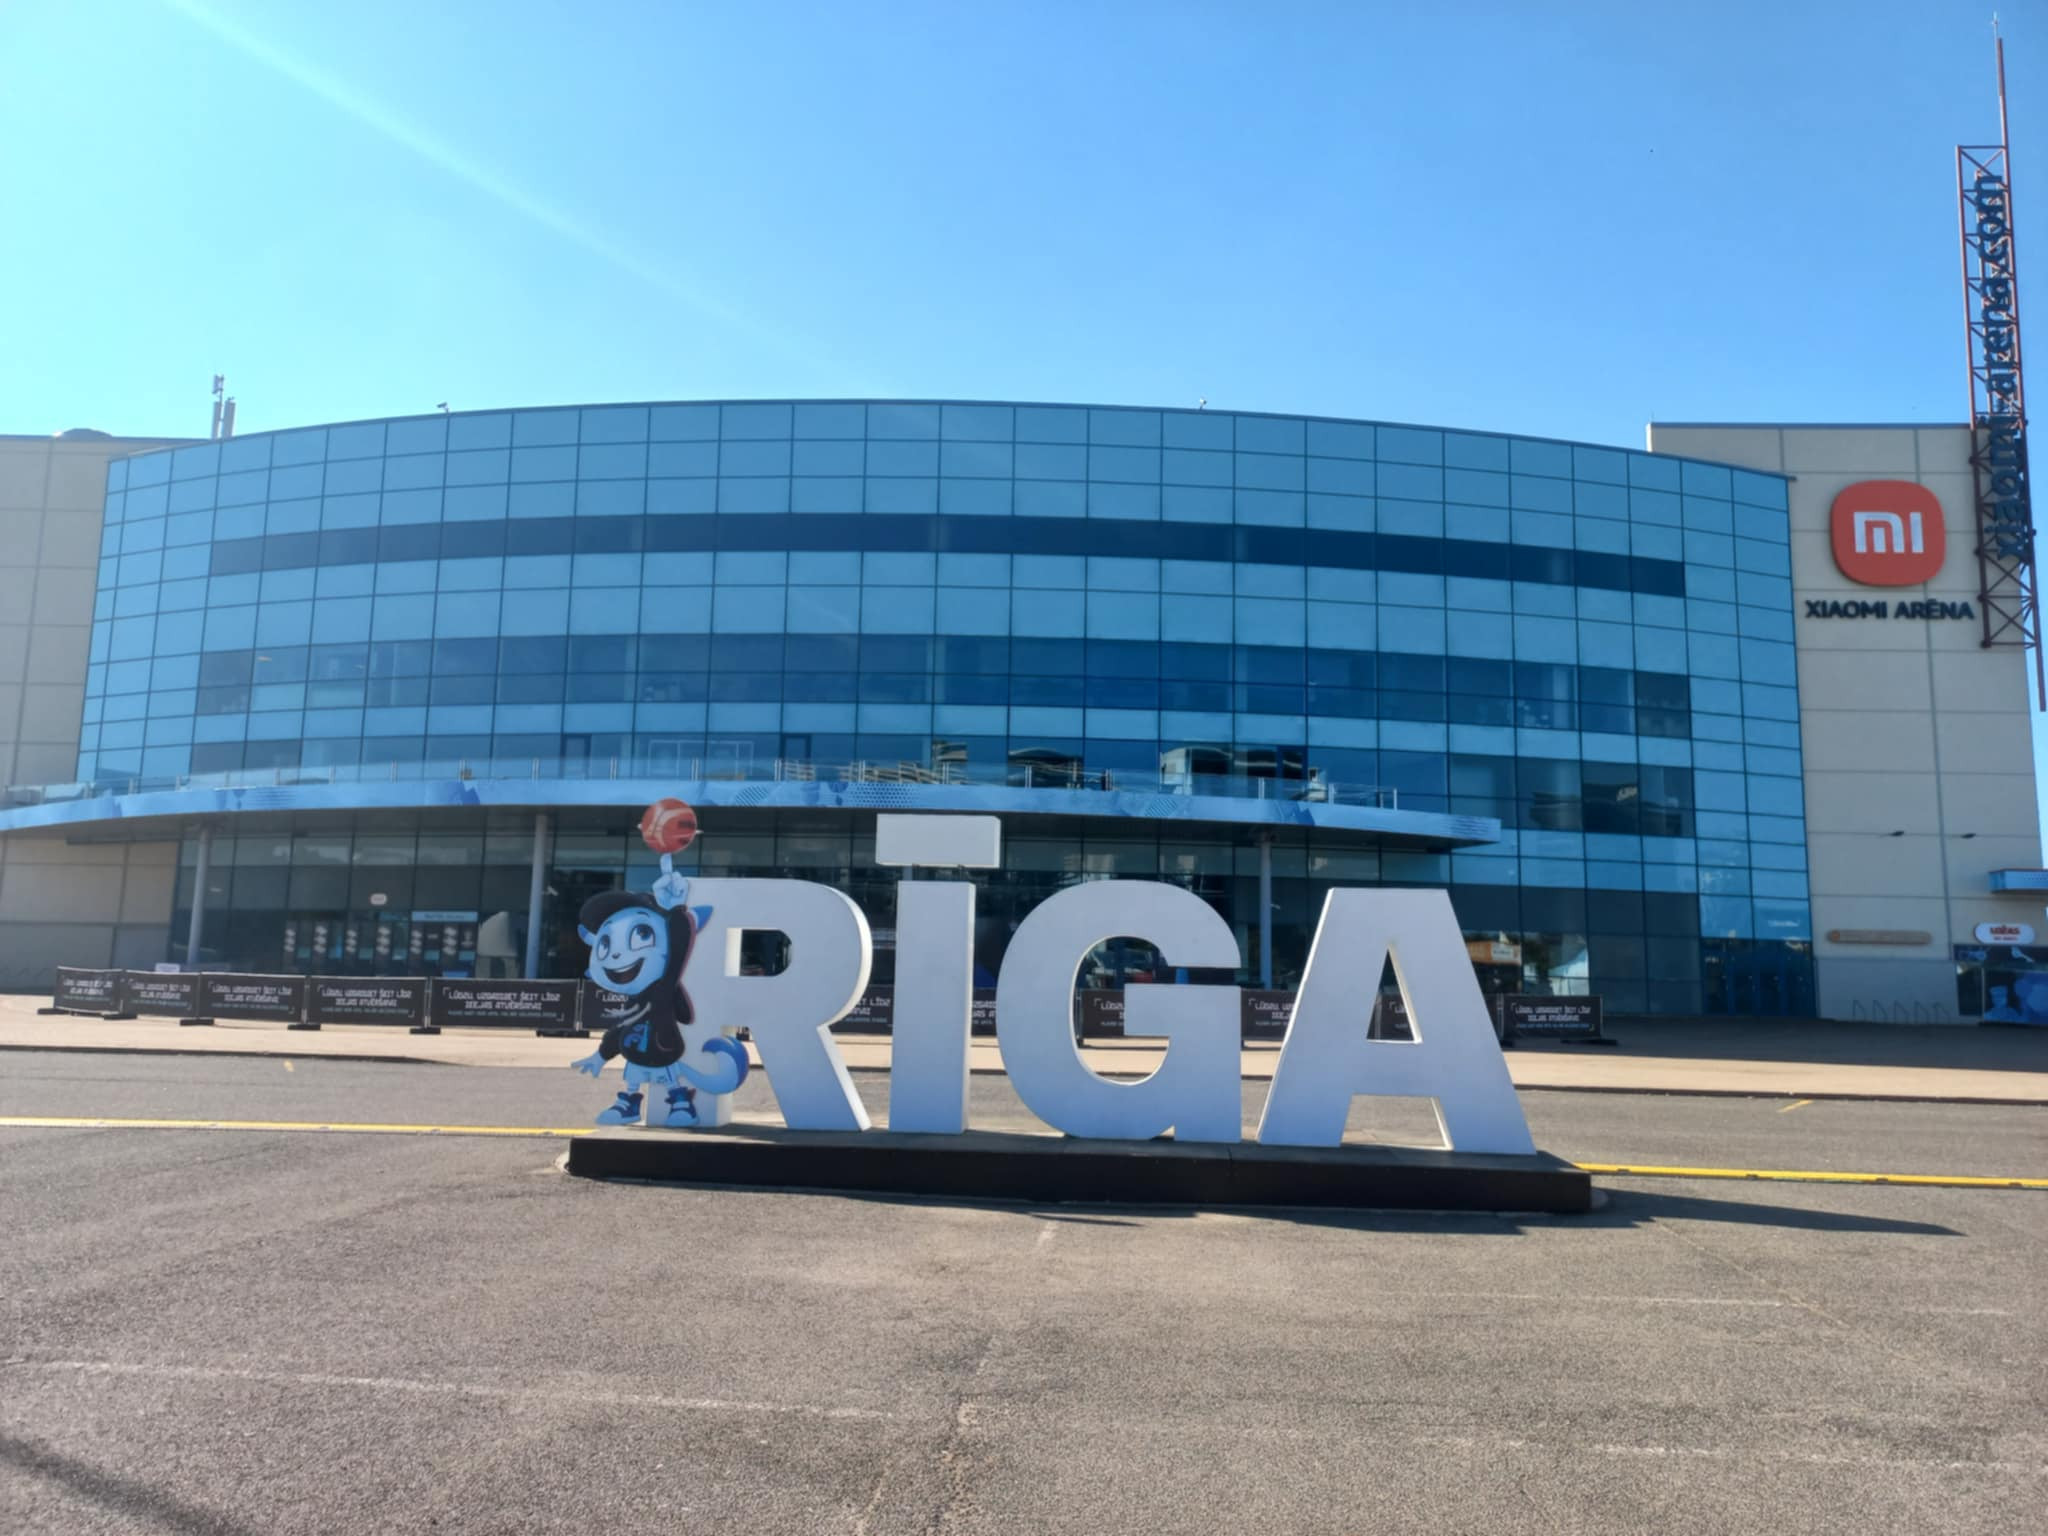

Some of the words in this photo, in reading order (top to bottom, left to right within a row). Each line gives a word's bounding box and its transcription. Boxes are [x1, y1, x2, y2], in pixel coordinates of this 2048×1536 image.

[1805, 600, 1888, 619] XIAOMI
[1894, 598, 1975, 620] ARĒNA
[645, 813, 1538, 1155] RĪGA
